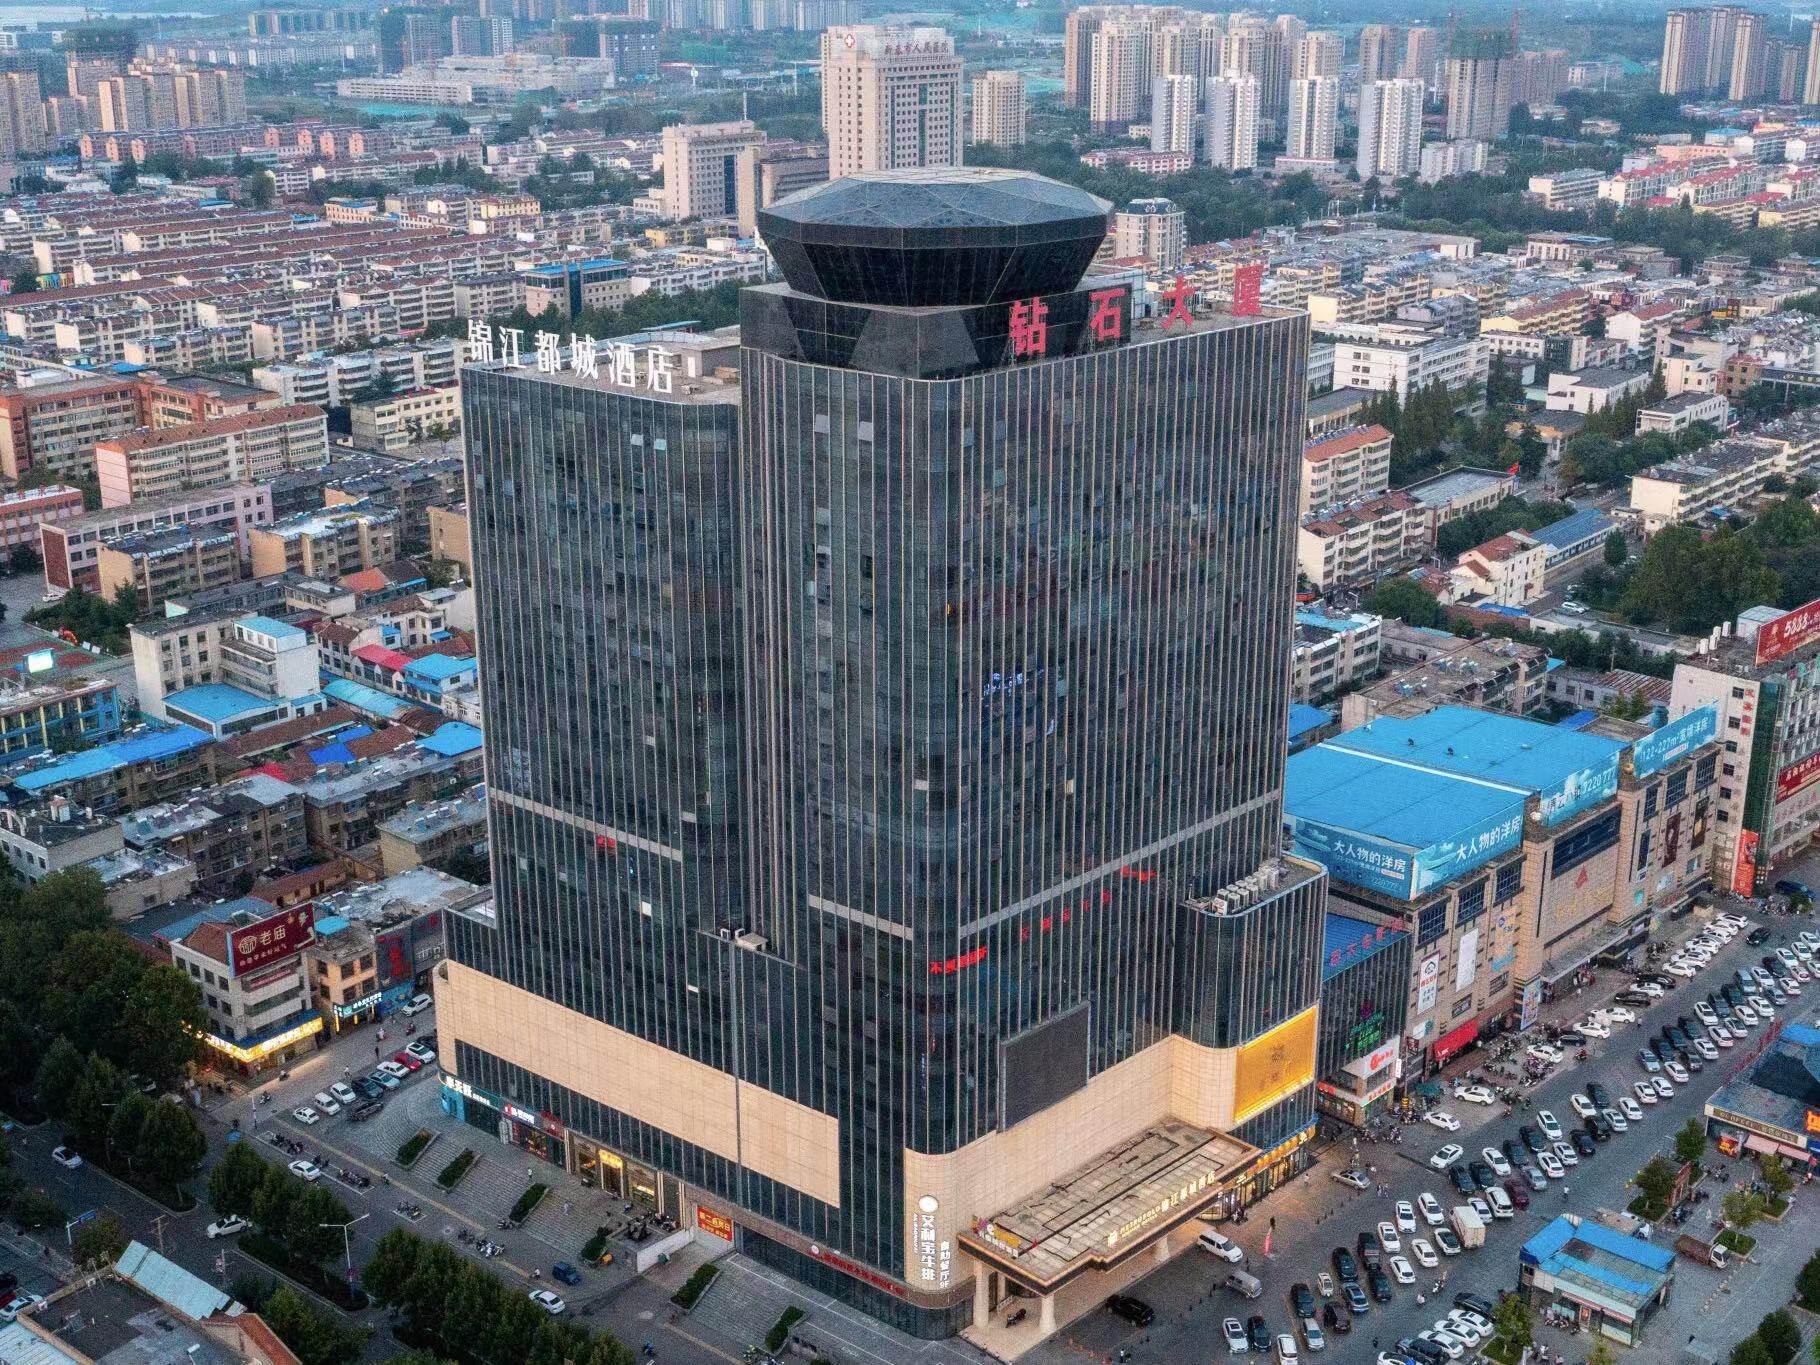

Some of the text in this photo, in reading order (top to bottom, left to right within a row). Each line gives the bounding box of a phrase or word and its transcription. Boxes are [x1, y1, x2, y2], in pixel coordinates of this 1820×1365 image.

[1009, 264, 1264, 357] 钻石大厦
[468, 319, 673, 394] 锦江都城酒店
[1333, 839, 1407, 872] 大人物的洋房
[1455, 815, 1521, 863] 大人物的洋房
[258, 924, 287, 946] 老庙
